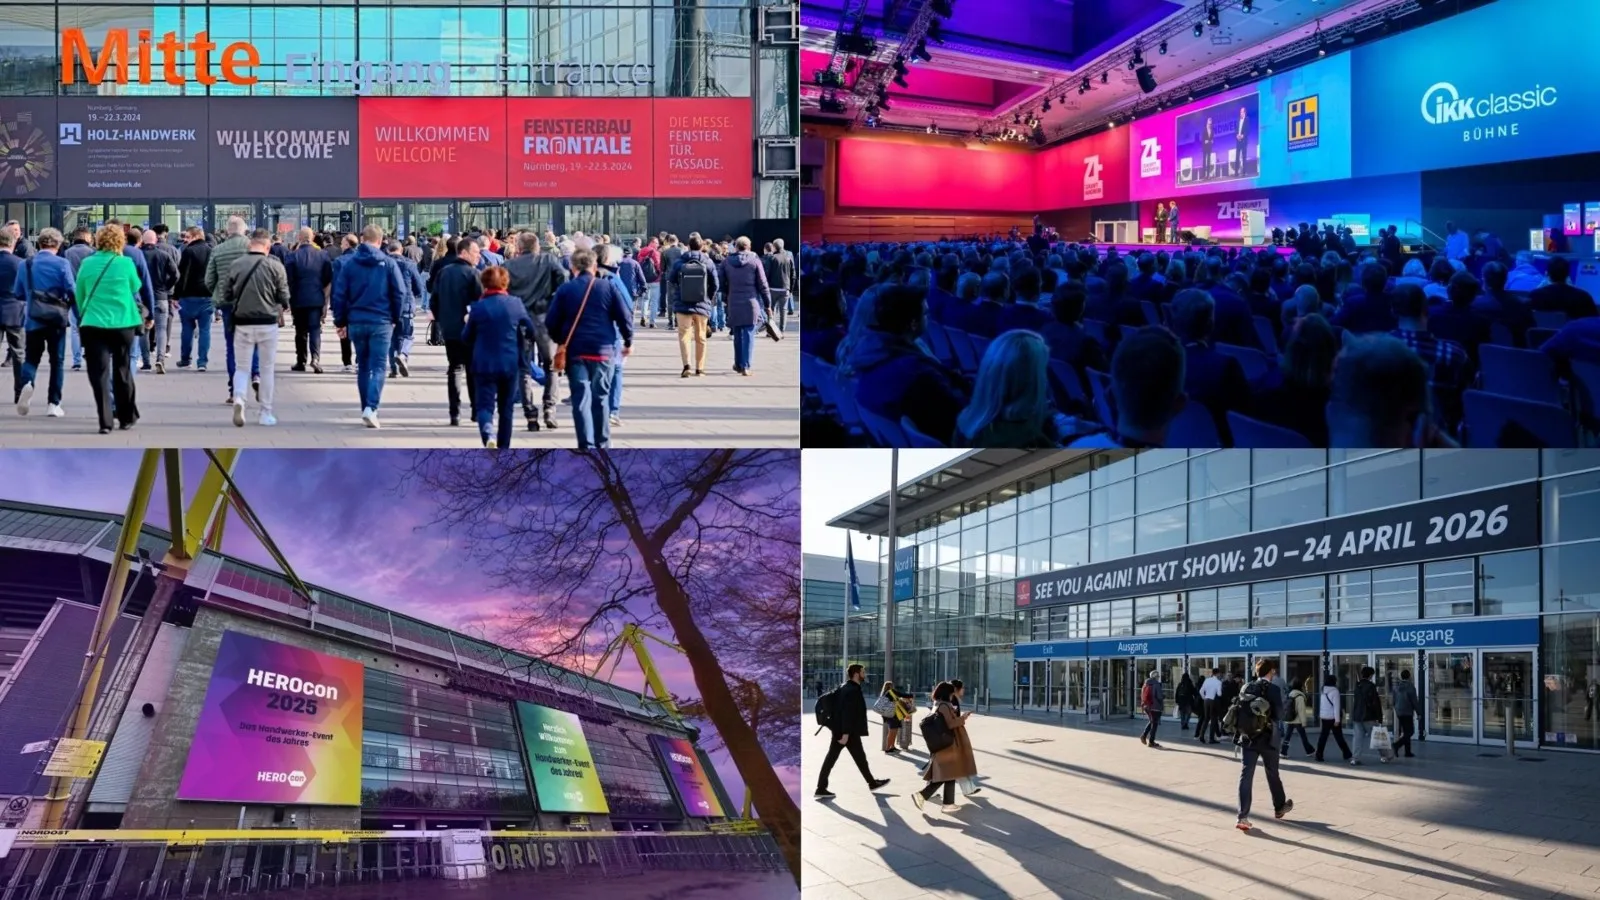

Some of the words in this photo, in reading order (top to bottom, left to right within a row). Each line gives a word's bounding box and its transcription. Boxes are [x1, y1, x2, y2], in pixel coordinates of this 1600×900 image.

[60, 28, 261, 85] Mitte
[285, 52, 452, 96] Eingang
[494, 51, 652, 87] Entrance
[1476, 84, 1557, 117] classic
[523, 119, 632, 134] FENSTERBAU
[669, 116, 689, 128] DIE
[693, 116, 734, 128] MESSE.
[87, 129, 196, 141] HOLZ-HANDWERK
[216, 130, 350, 146] WILLKOMMEN
[375, 126, 490, 142] WILLKOMMEN
[669, 130, 722, 142] FENSTER.
[1463, 123, 1519, 142] BÜHNE
[233, 142, 333, 159] WELCOME
[375, 146, 457, 162] WELCOME
[669, 142, 695, 156] TÜR.
[669, 158, 724, 170] FASSADE.
[1034, 582, 1053, 600] SEE
[1056, 576, 1082, 596] YOU
[1083, 567, 1132, 593] AGAIN!
[1136, 560, 1178, 586] NEXT
[1181, 550, 1245, 579] SHOW:
[1251, 544, 1278, 569] 20
[1301, 534, 1331, 562] 24
[1337, 521, 1416, 558] APRIL
[1425, 504, 1509, 544] 2026
[1042, 646, 1053, 654] Exit
[1118, 642, 1148, 654] Ausgang
[1239, 636, 1258, 647] Exit
[1390, 628, 1454, 645] Ausgang
[247, 668, 338, 700] HEROcon
[266, 692, 318, 715] 2025
[239, 722, 257, 731] Das
[259, 724, 334, 741] Handwerker-Event
[265, 735, 281, 744] des
[282, 737, 309, 747] Jahres
[257, 771, 287, 783] HERO
[289, 774, 305, 782] con
